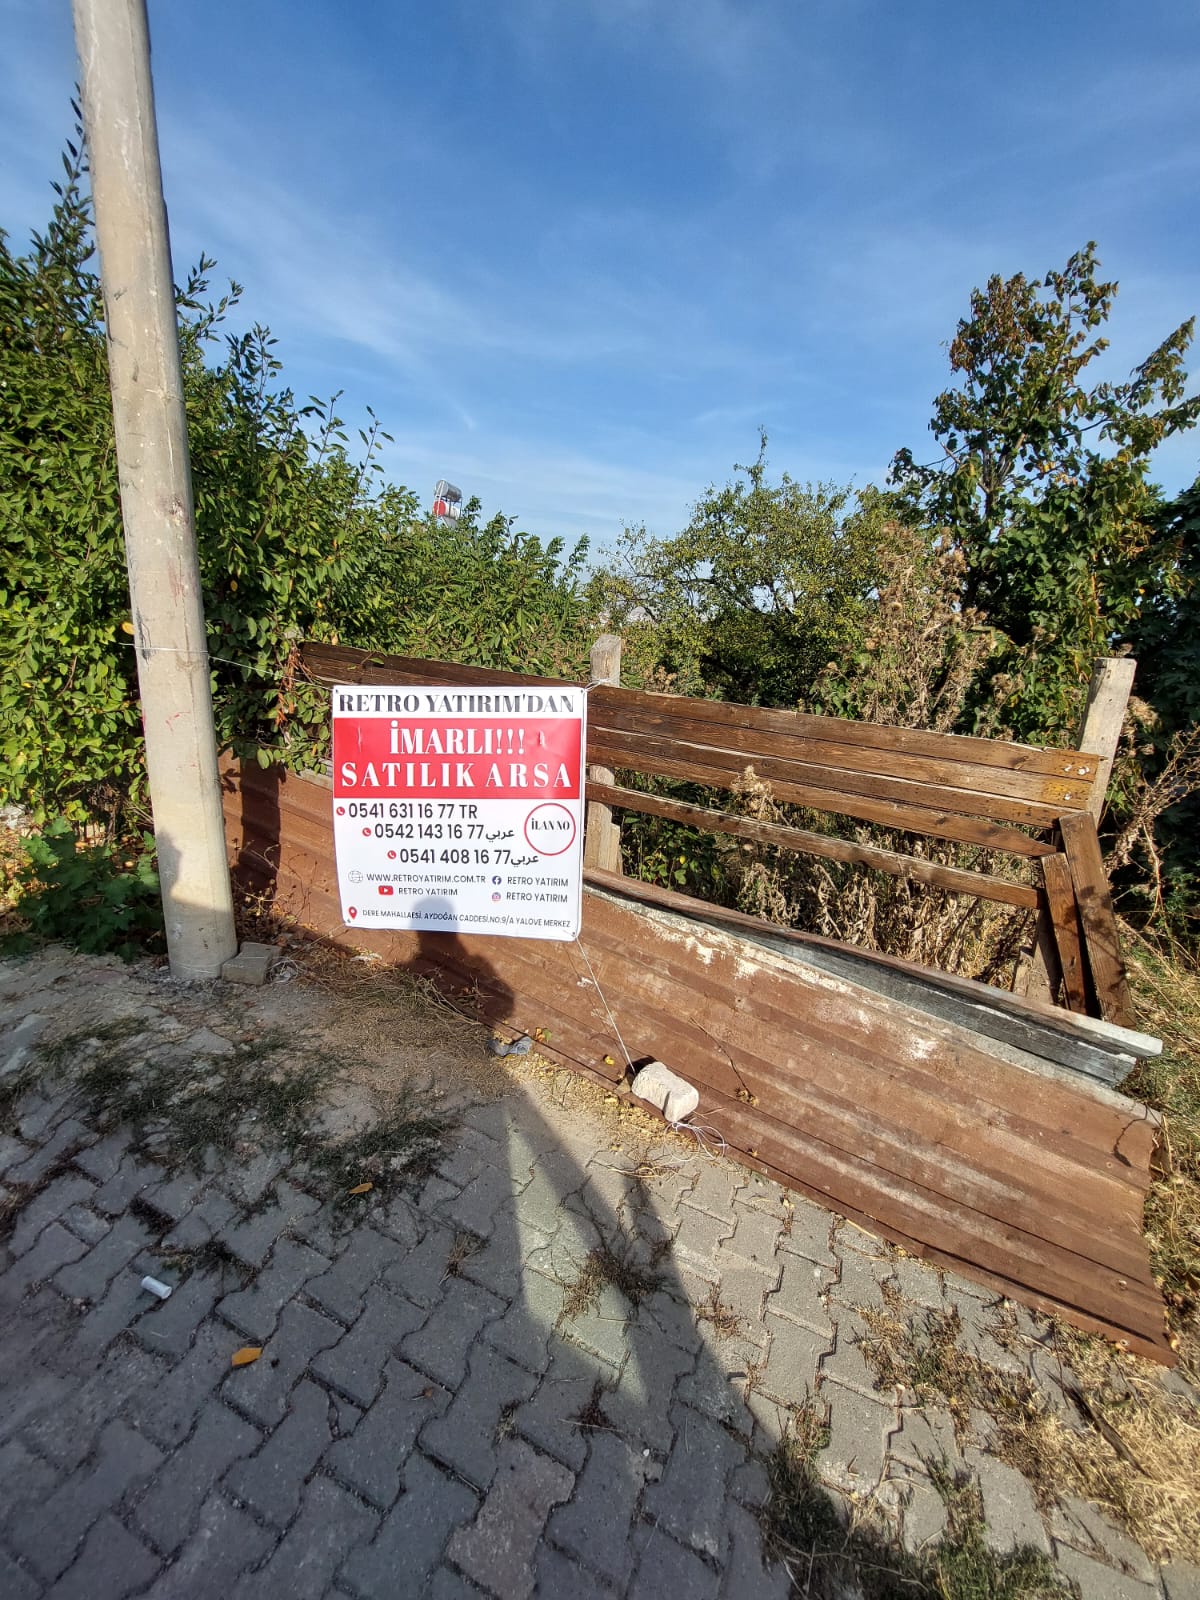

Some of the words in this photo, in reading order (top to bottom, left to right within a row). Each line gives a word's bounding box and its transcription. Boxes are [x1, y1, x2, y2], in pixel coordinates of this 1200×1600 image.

[339, 694, 420, 712] RETRO
[424, 694, 574, 713] YATIRIM'DAN
[389, 720, 525, 755] İMARLI!!!
[341, 762, 476, 787] SATILIK
[485, 763, 572, 788] ARSA
[348, 802, 384, 818] 0541
[389, 802, 414, 818] 631
[418, 803, 433, 818] 16
[438, 804, 454, 819] 77
[459, 804, 478, 819] TR
[532, 818, 554, 830] İLAN
[556, 820, 570, 830] NO
[374, 824, 414, 838] 0542
[418, 824, 443, 839] 143
[448, 824, 462, 839] 16
[467, 824, 484, 840] 77
[400, 848, 435, 864] 0541
[440, 849, 470, 864] 408
[474, 850, 490, 864] 16
[494, 850, 510, 864] 77
[366, 873, 486, 884] WWW.RETROYATIRIM.COM.TR
[507, 876, 533, 885] RETRO
[535, 877, 568, 887] YATIRIM
[398, 887, 424, 896] RETRO
[426, 888, 458, 896] YATIRIM
[506, 892, 532, 901] RETRO
[534, 893, 568, 903] YATIRIM
[544, 919, 571, 928] MERKEZ
